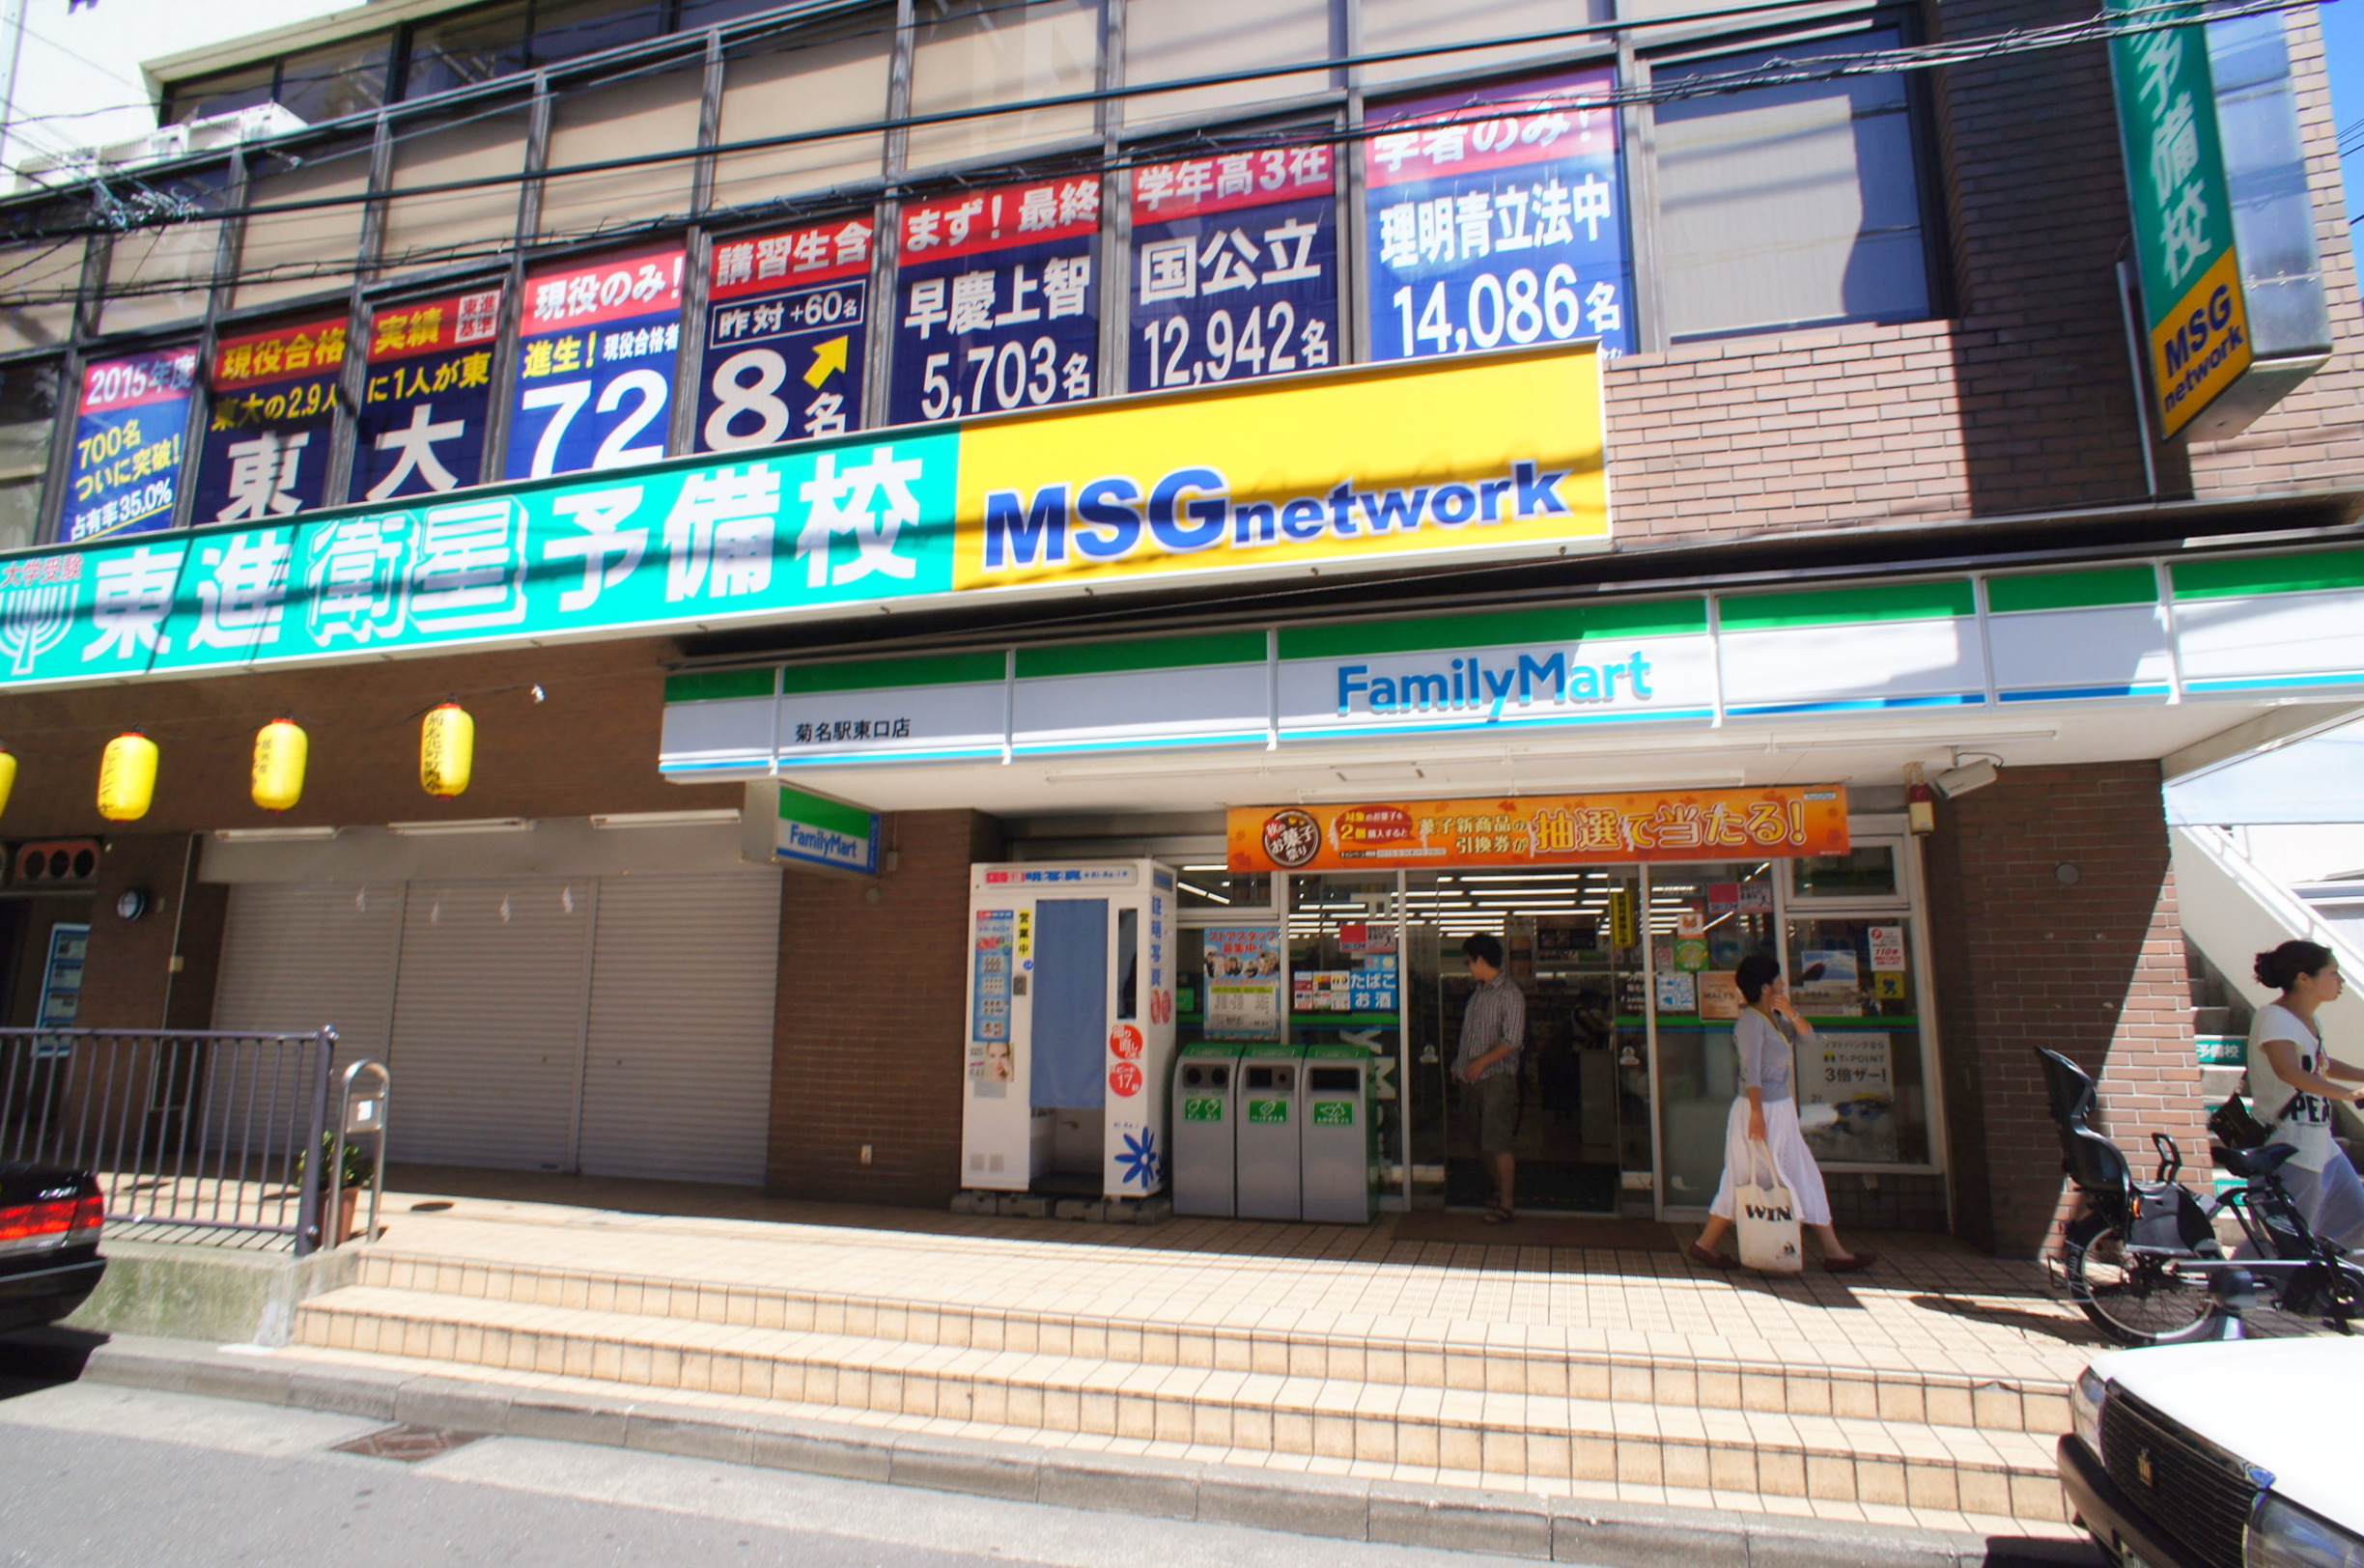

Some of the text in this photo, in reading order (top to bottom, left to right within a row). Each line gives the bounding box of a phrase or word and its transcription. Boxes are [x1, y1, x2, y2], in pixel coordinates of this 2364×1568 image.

[1380, 173, 1611, 269] 理明青立法中
[717, 222, 873, 287] 講習生含
[1140, 218, 1322, 306] 国公立
[534, 256, 683, 322] 現役のみ!
[904, 255, 1092, 340] 早慶上智
[1143, 300, 1330, 387] 12,942名
[2164, 284, 2233, 378] MSG
[87, 354, 196, 406] 2015年度
[921, 335, 1091, 419] 5,703名
[2163, 325, 2244, 413] network
[78, 419, 141, 469] 700名
[521, 369, 668, 481] 72
[1, 552, 84, 587] 大学受験
[1337, 652, 1652, 722] FamilyMart
[796, 716, 911, 742] 菊名駅東口店
[789, 823, 858, 858] FamilyMart
[1351, 972, 1396, 991] たばこ
[1354, 992, 1393, 1010] お酒
[1745, 1203, 1792, 1222] WIN
